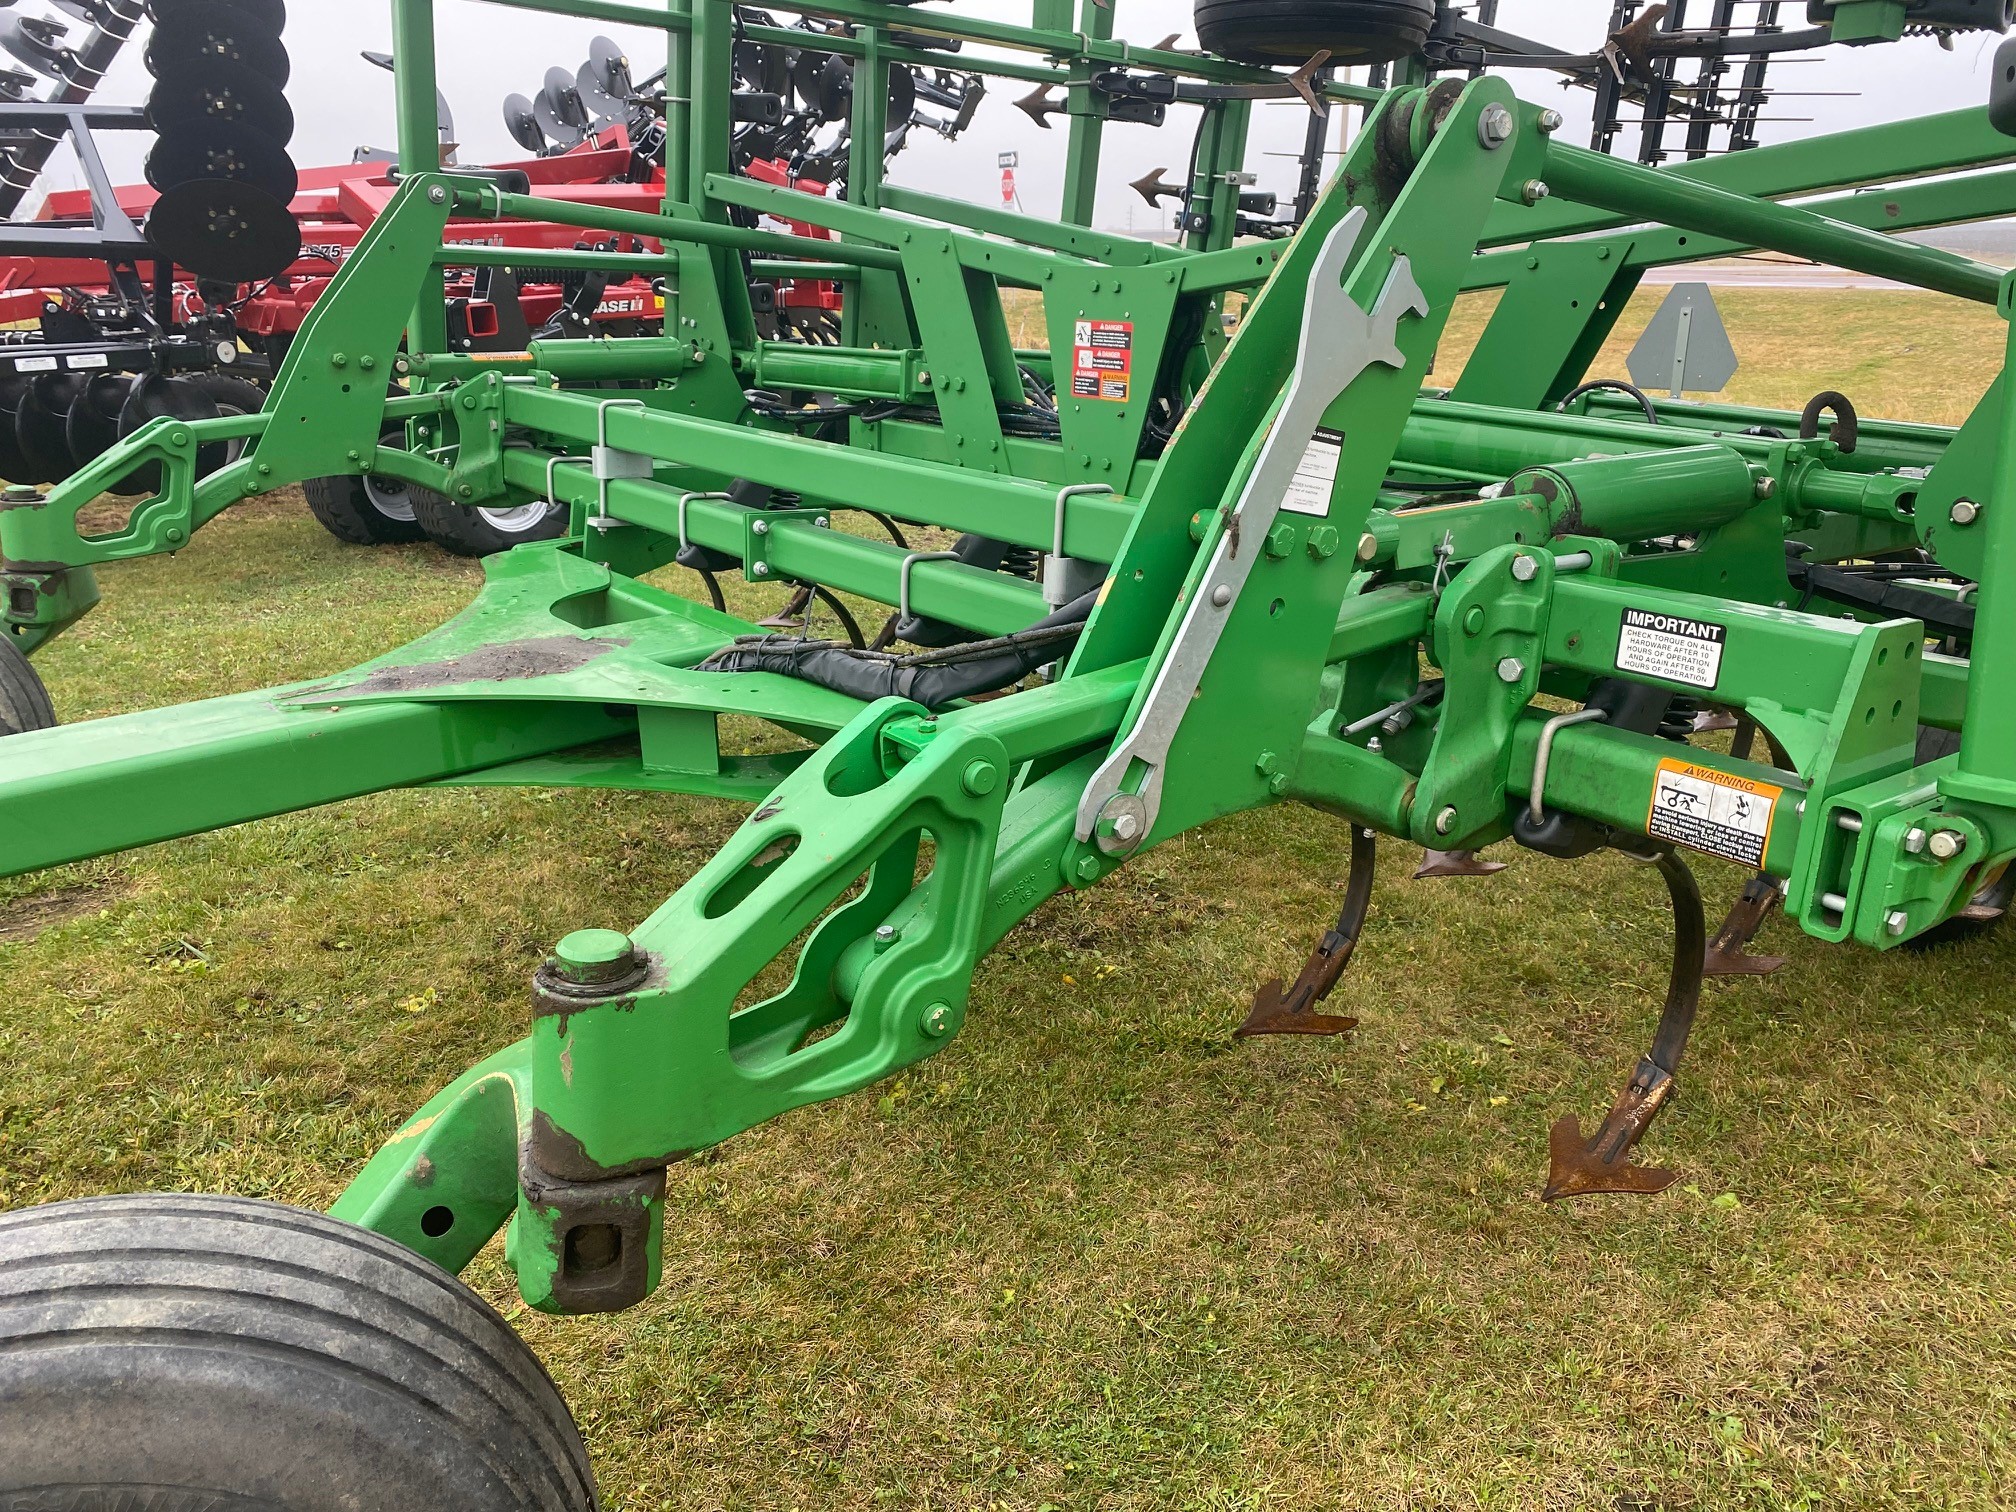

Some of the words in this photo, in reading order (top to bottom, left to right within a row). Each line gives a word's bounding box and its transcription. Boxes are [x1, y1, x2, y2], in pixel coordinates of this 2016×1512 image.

[593, 300, 628, 314] ASE
[1626, 610, 1722, 640] IMPORTANT
[1627, 630, 1652, 640] CHECK
[1655, 634, 1685, 646] TORQUE
[1630, 638, 1672, 652] HARDWARE
[1674, 647, 1698, 658] AFTER
[1627, 645, 1652, 655] HOURS
[1666, 653, 1710, 667] OPERATION
[1646, 657, 1669, 666] AGAIN
[1670, 662, 1694, 672] AFTER
[1624, 660, 1650, 670] HOURS
[1664, 668, 1707, 682] OPERATION
[1696, 768, 1755, 791] WARNING
[1653, 814, 1678, 823] machine
[1679, 820, 1706, 832] lowering
[1739, 838, 1762, 848] control
[1678, 814, 1699, 824] serious
[1700, 820, 1717, 830] injury
[1726, 828, 1742, 836] death
[1652, 819, 1670, 829] during
[1701, 833, 1722, 843] CLOSE
[1723, 839, 1743, 850] lockup
[1744, 847, 1761, 855] valve
[1660, 826, 1686, 839] INSTALL
[1688, 836, 1714, 847] cylinder
[1716, 844, 1736, 853] clevis
[1738, 849, 1756, 859] locks
[1020, 886, 1038, 904] USA
